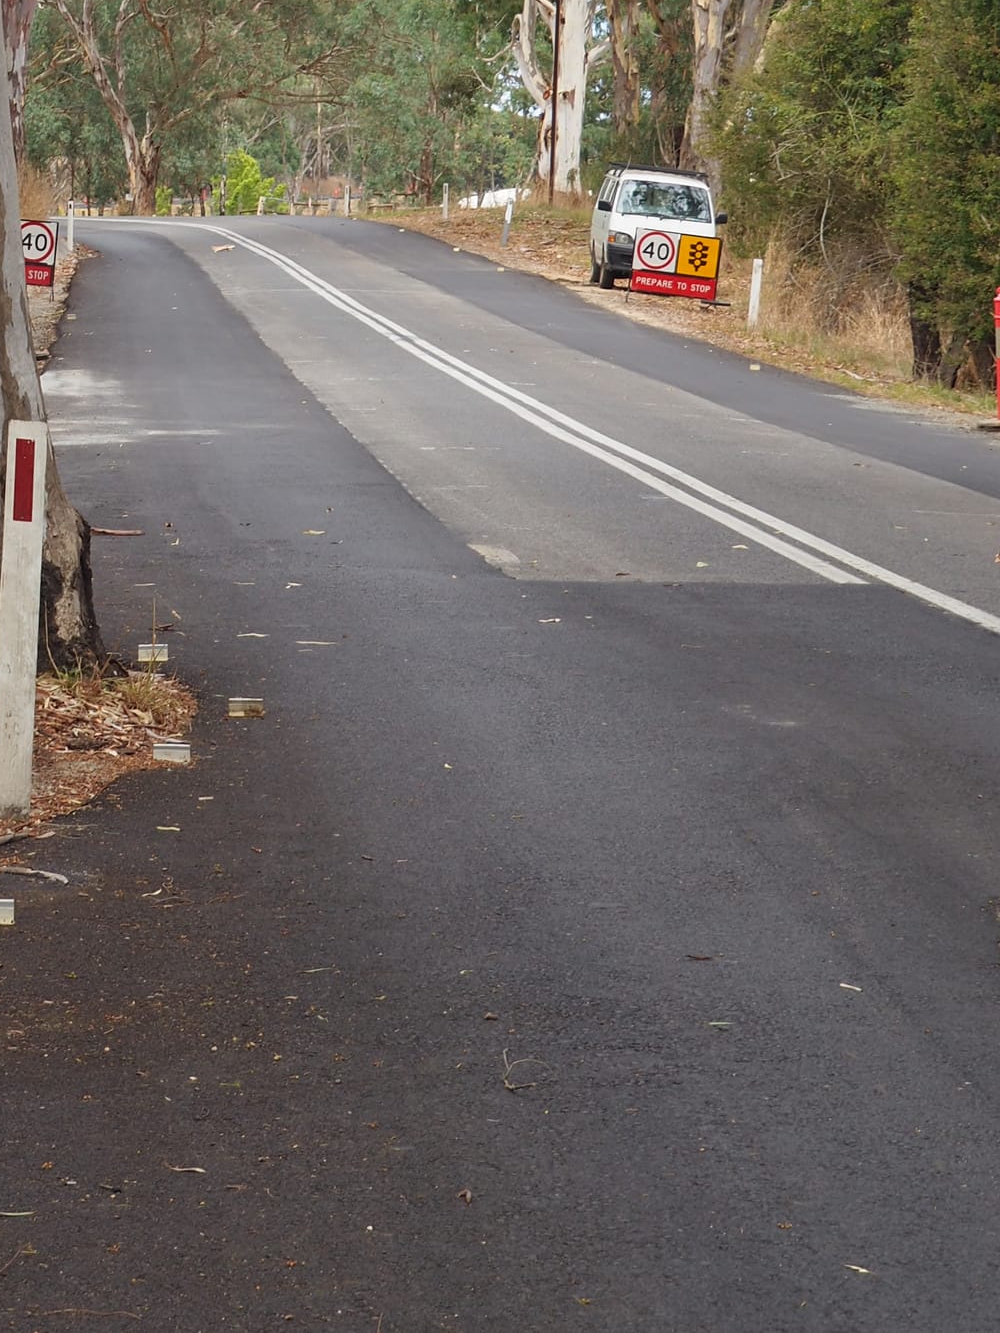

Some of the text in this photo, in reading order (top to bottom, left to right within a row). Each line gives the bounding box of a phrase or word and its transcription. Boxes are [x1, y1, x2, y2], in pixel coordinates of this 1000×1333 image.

[22, 233, 47, 251] 40
[642, 242, 669, 260] 40
[27, 269, 49, 280] STOP
[636, 276, 711, 293] PREPARE TO STOP
